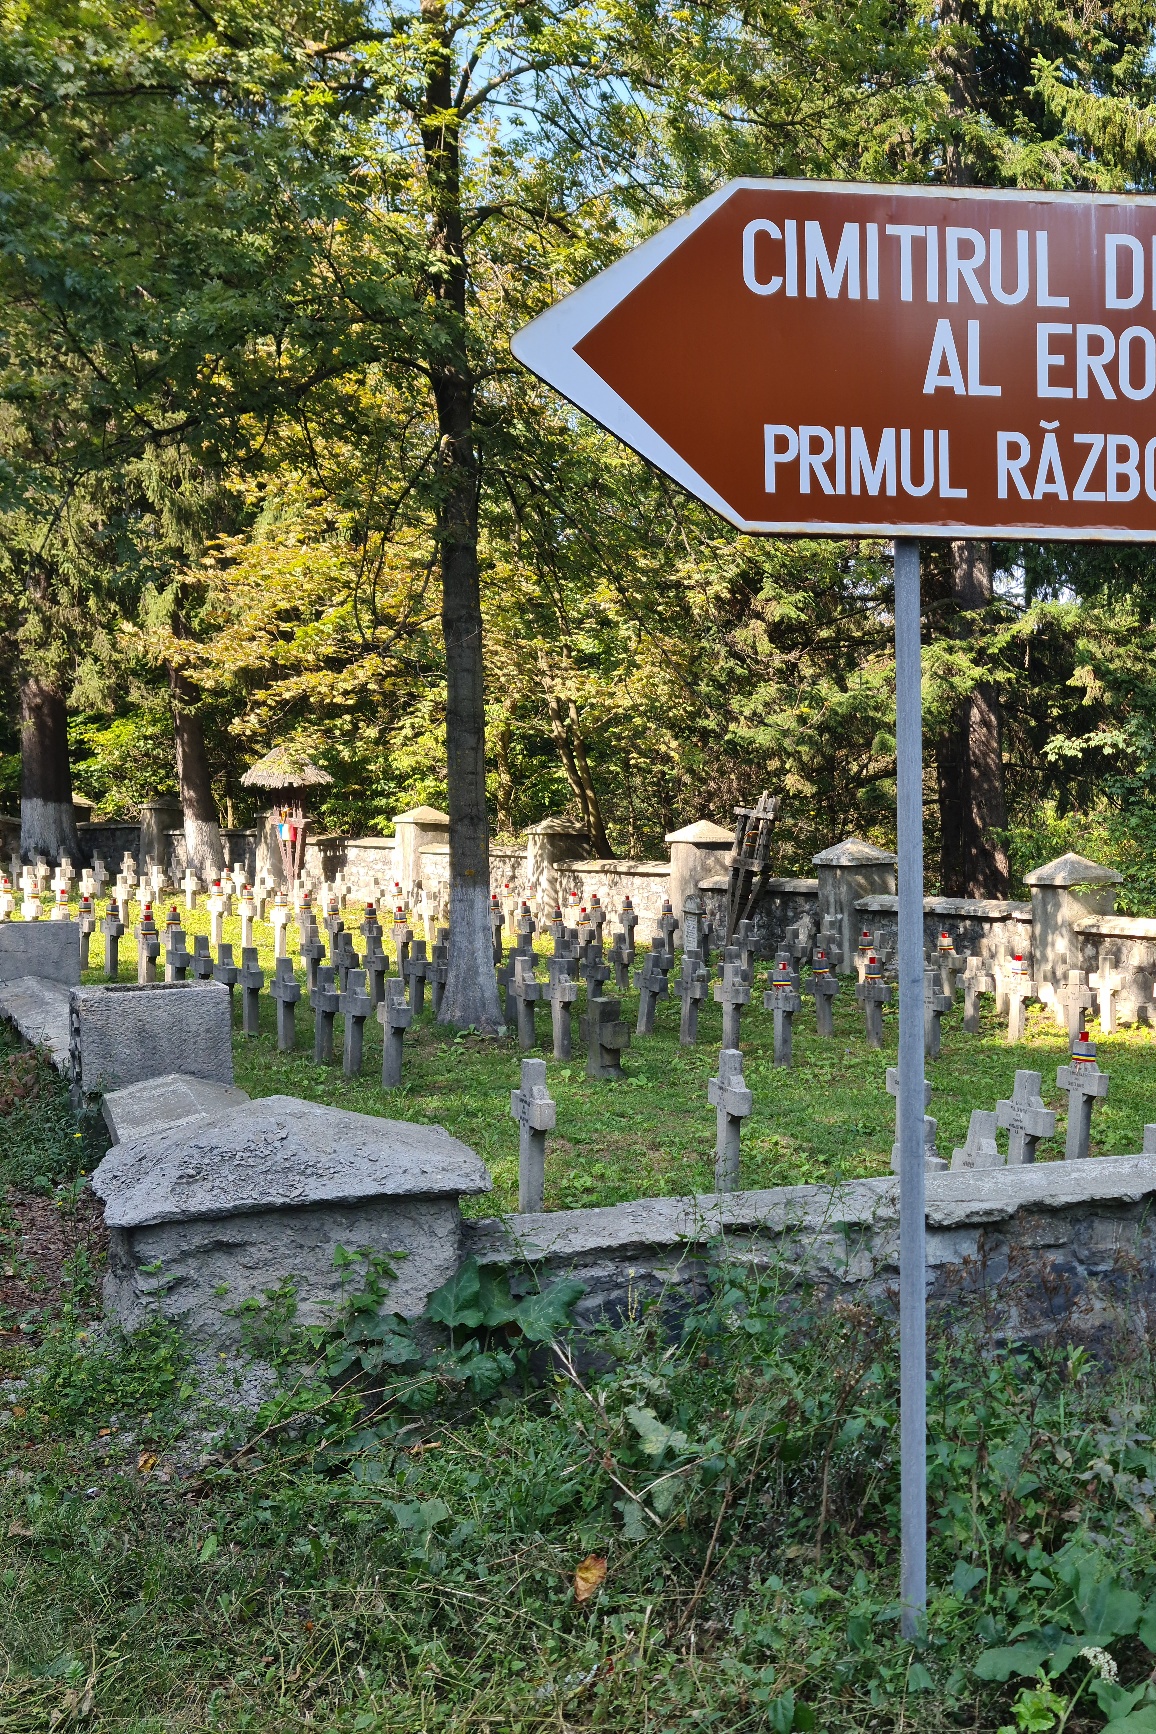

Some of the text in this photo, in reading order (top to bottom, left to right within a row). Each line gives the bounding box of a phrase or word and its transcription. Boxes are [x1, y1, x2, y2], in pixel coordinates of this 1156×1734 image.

[742, 218, 1070, 308] CIMITIRUL
[922, 318, 1002, 397] AL
[763, 423, 968, 499] PRIMUL
